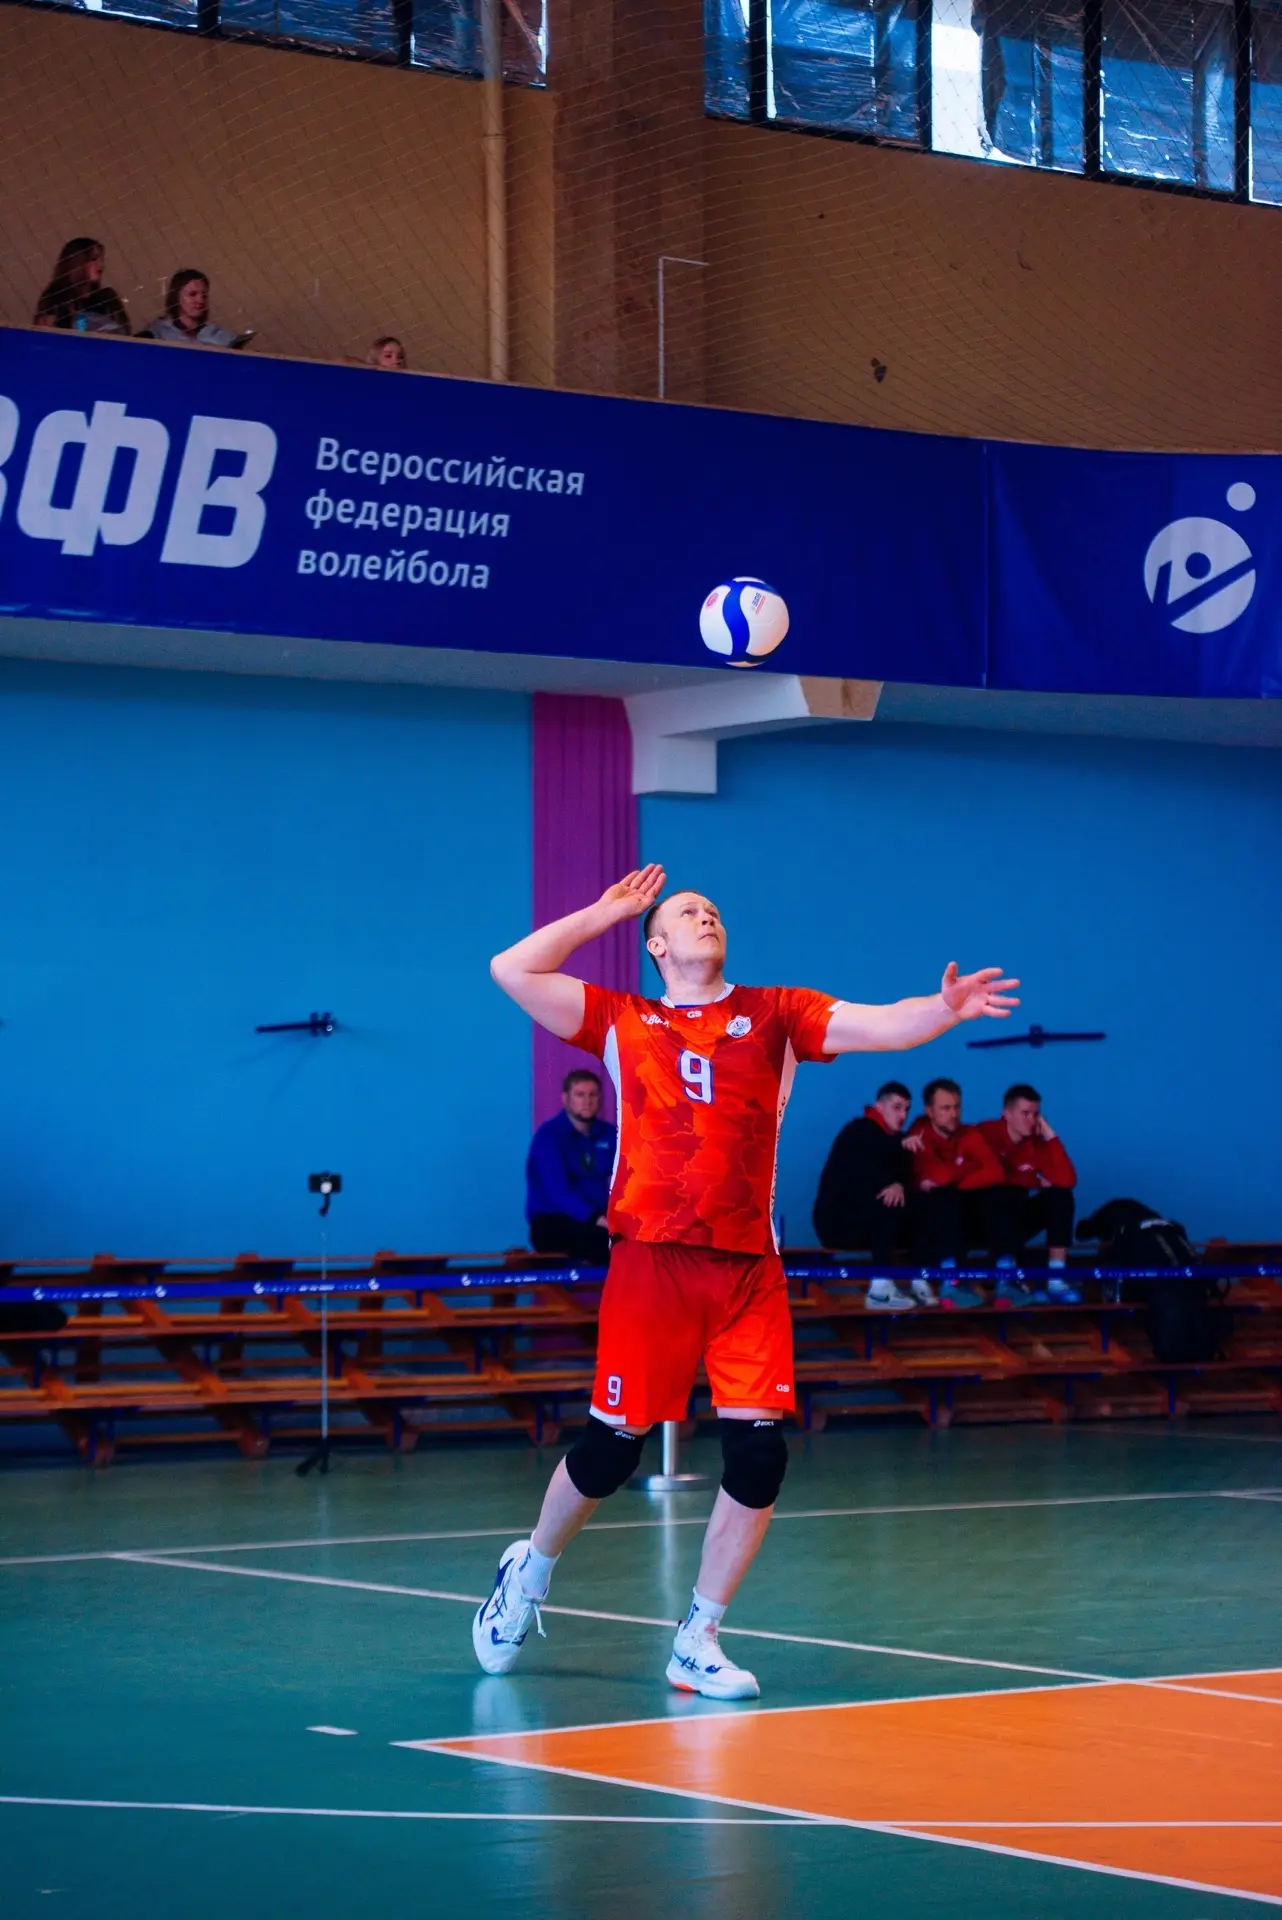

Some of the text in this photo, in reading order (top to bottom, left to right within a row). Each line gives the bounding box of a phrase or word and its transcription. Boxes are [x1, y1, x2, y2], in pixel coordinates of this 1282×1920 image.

[0, 395, 278, 568] ФВ
[315, 437, 585, 496] Всероссийская
[305, 489, 510, 538] федерация
[297, 548, 490, 589] волейбола
[678, 1049, 715, 1105] 9
[607, 1375, 622, 1407] 9
